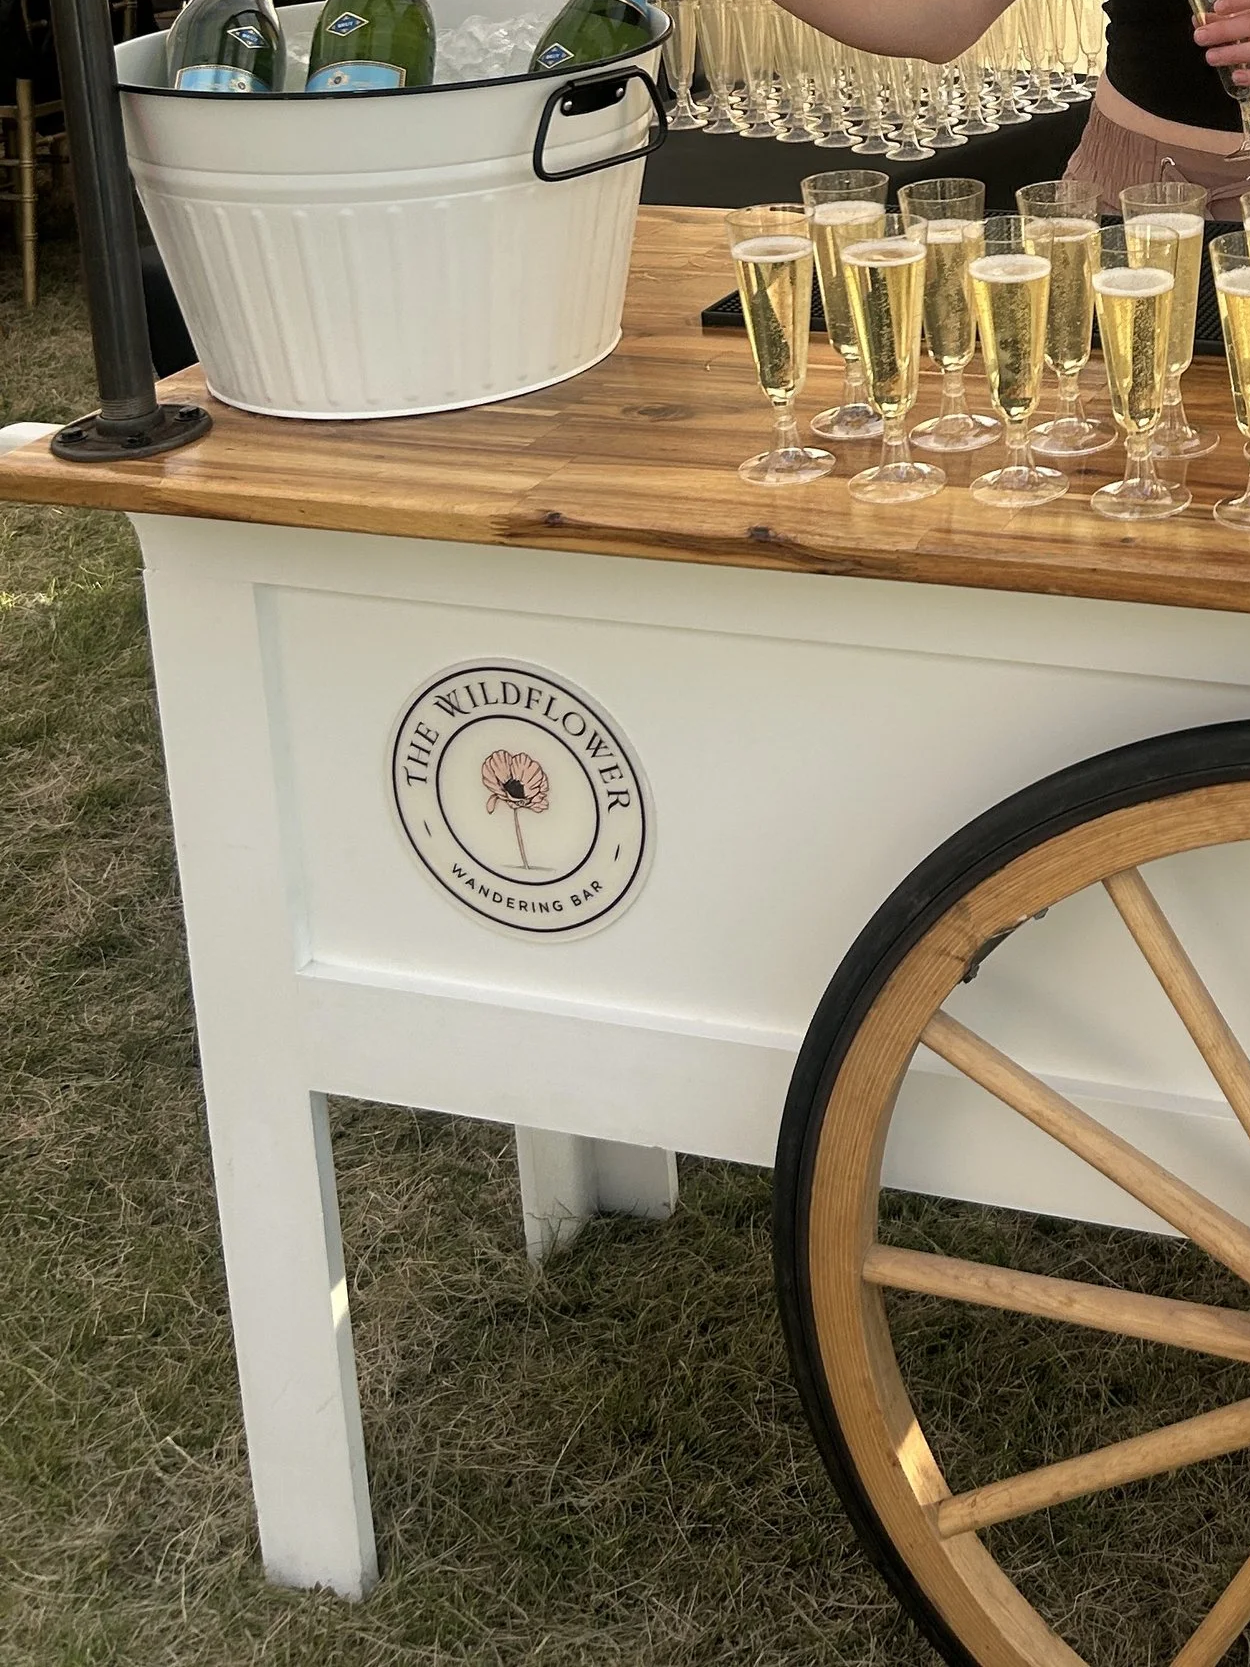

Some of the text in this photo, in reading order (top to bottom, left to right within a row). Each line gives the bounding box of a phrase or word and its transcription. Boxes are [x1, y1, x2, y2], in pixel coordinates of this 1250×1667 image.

[403, 681, 631, 814] THE WILDFLOWER
[452, 863, 603, 914] WANDERING BAR
